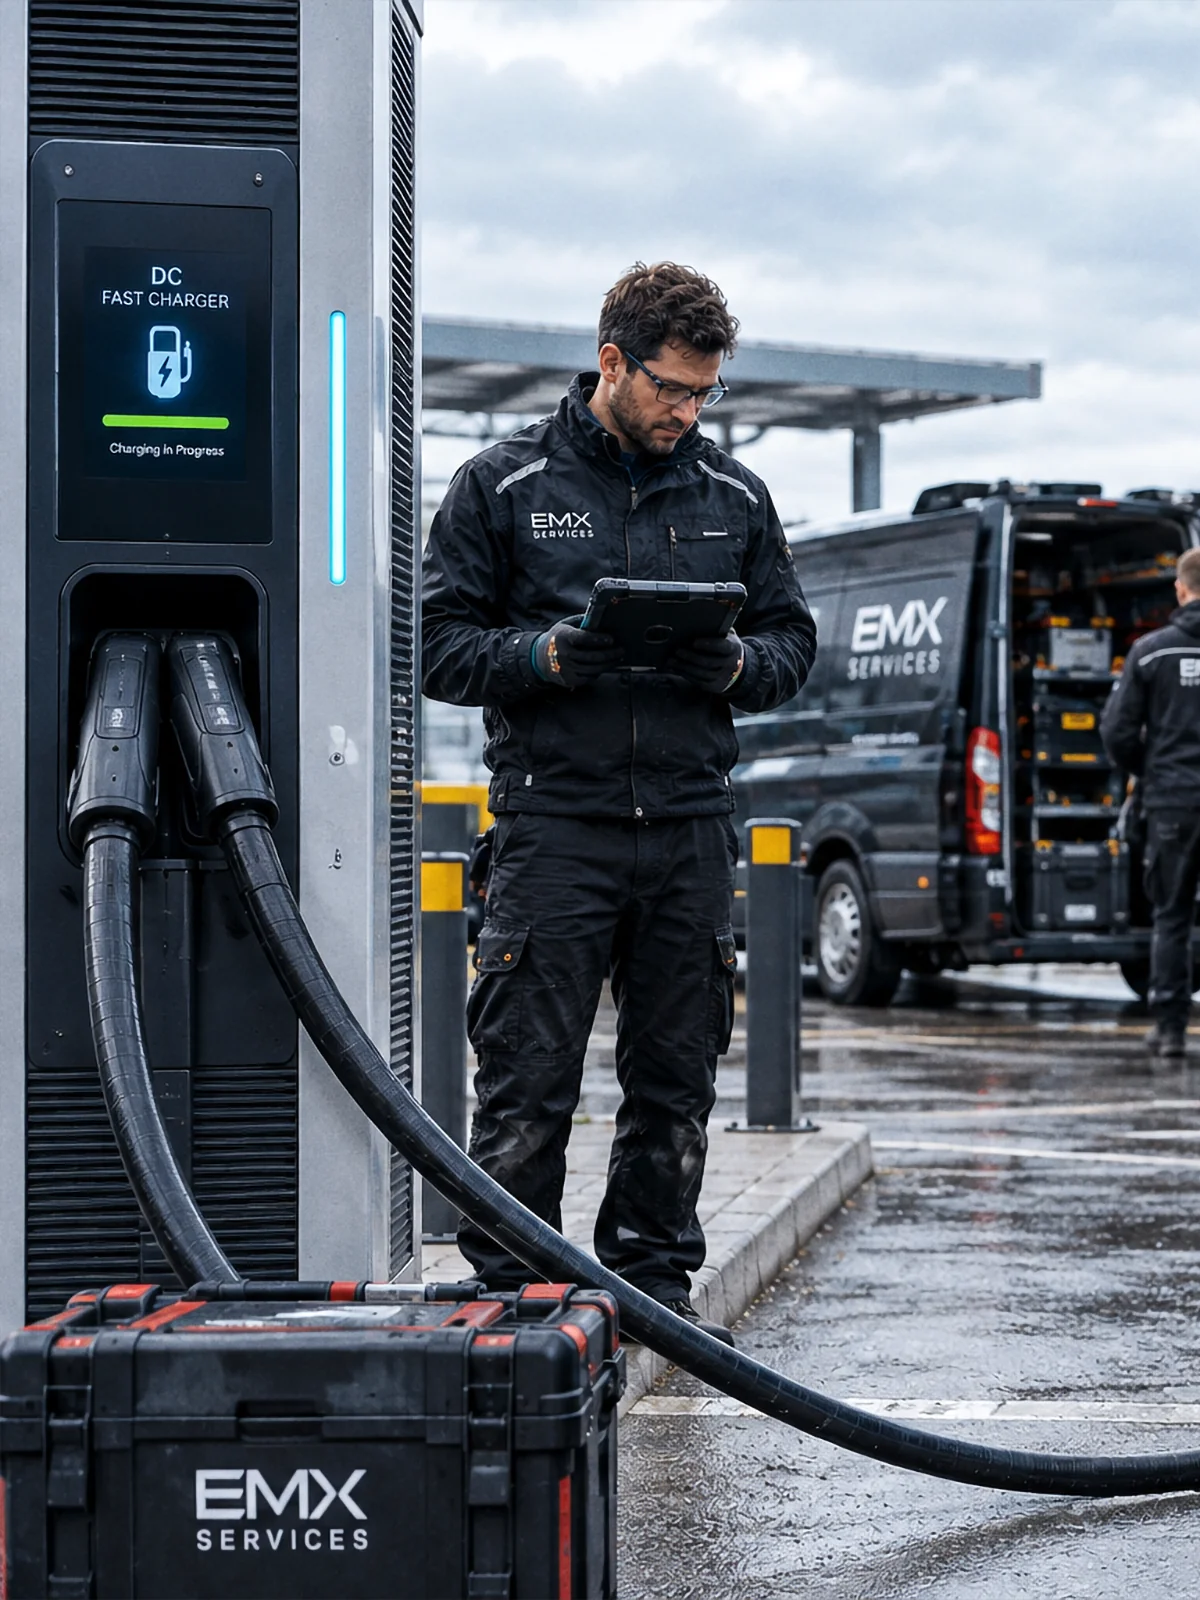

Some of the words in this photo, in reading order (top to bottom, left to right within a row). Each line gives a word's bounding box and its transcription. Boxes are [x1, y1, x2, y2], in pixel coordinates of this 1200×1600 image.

[151, 266, 182, 286] DC
[102, 290, 144, 306] FAST
[148, 292, 229, 308] CHARGER
[109, 442, 160, 458] Charging
[531, 512, 592, 528] EMX
[851, 597, 948, 652] EMX
[848, 649, 940, 681] SERVICES
[196, 1469, 368, 1520] EMX
[196, 1528, 368, 1551] SERVICES
